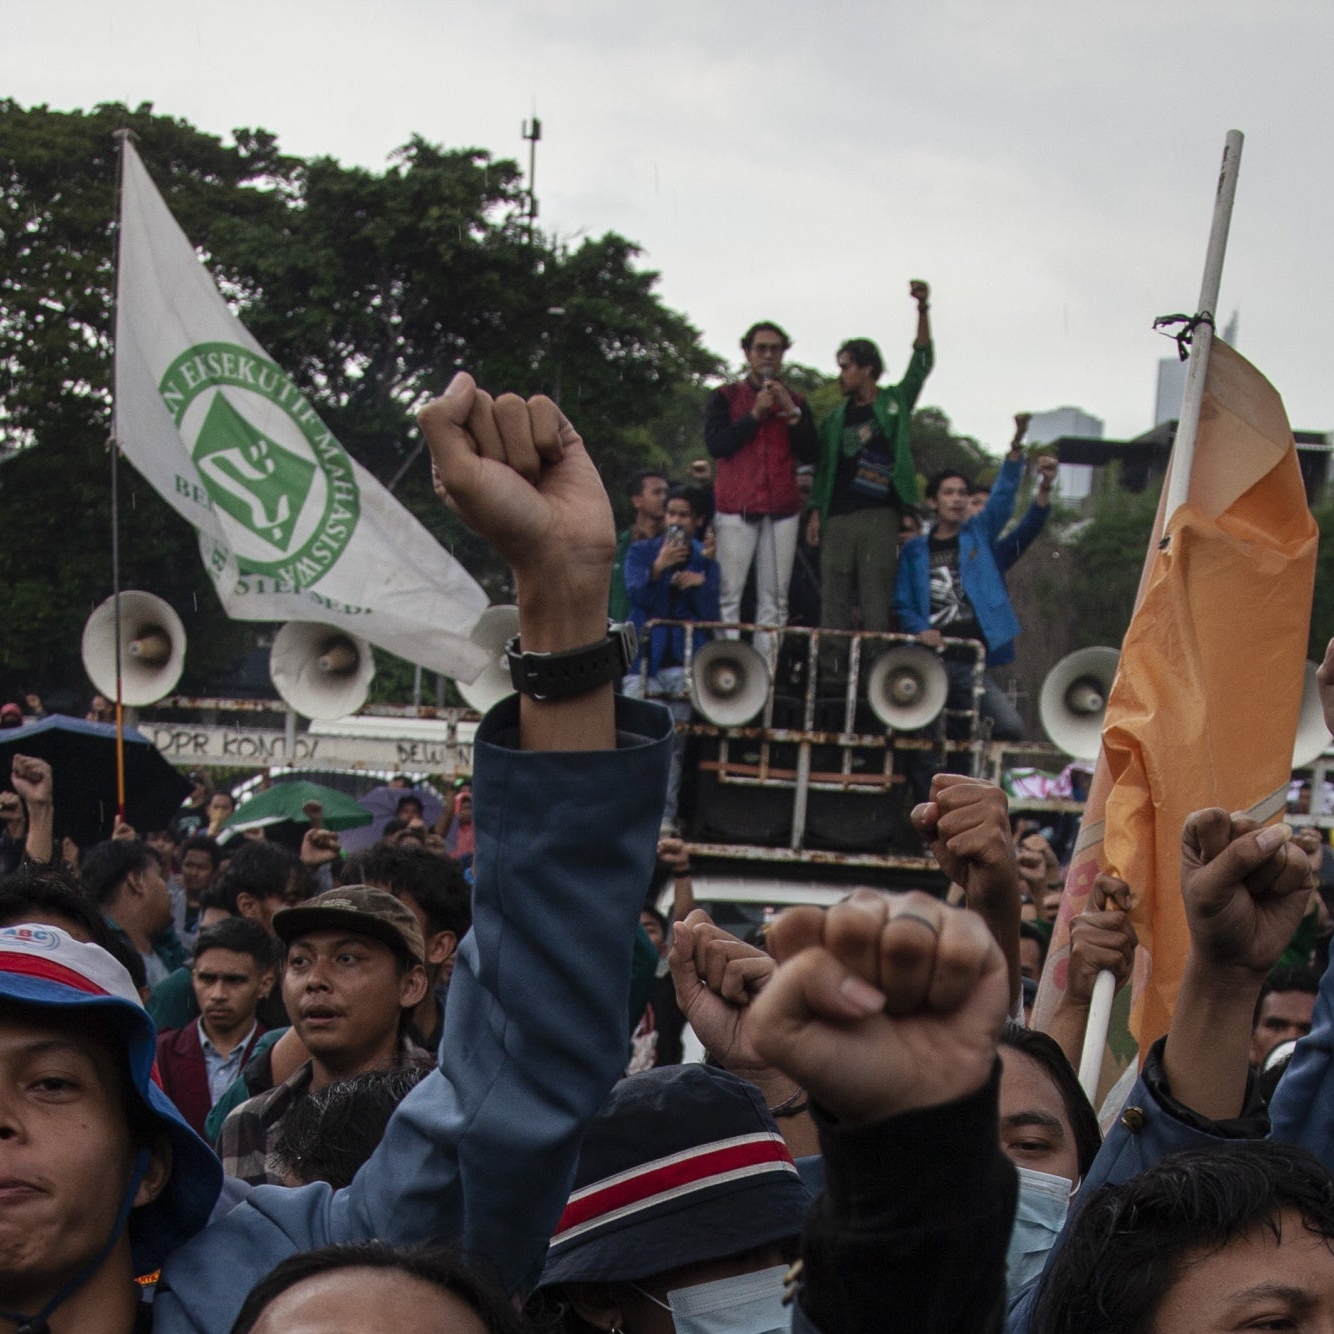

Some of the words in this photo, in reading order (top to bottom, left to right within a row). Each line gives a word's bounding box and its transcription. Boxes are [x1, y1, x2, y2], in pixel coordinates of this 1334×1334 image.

[277, 432, 355, 586] MAHASISWA
[153, 729, 209, 752] DPR
[2, 928, 49, 941] ABC
